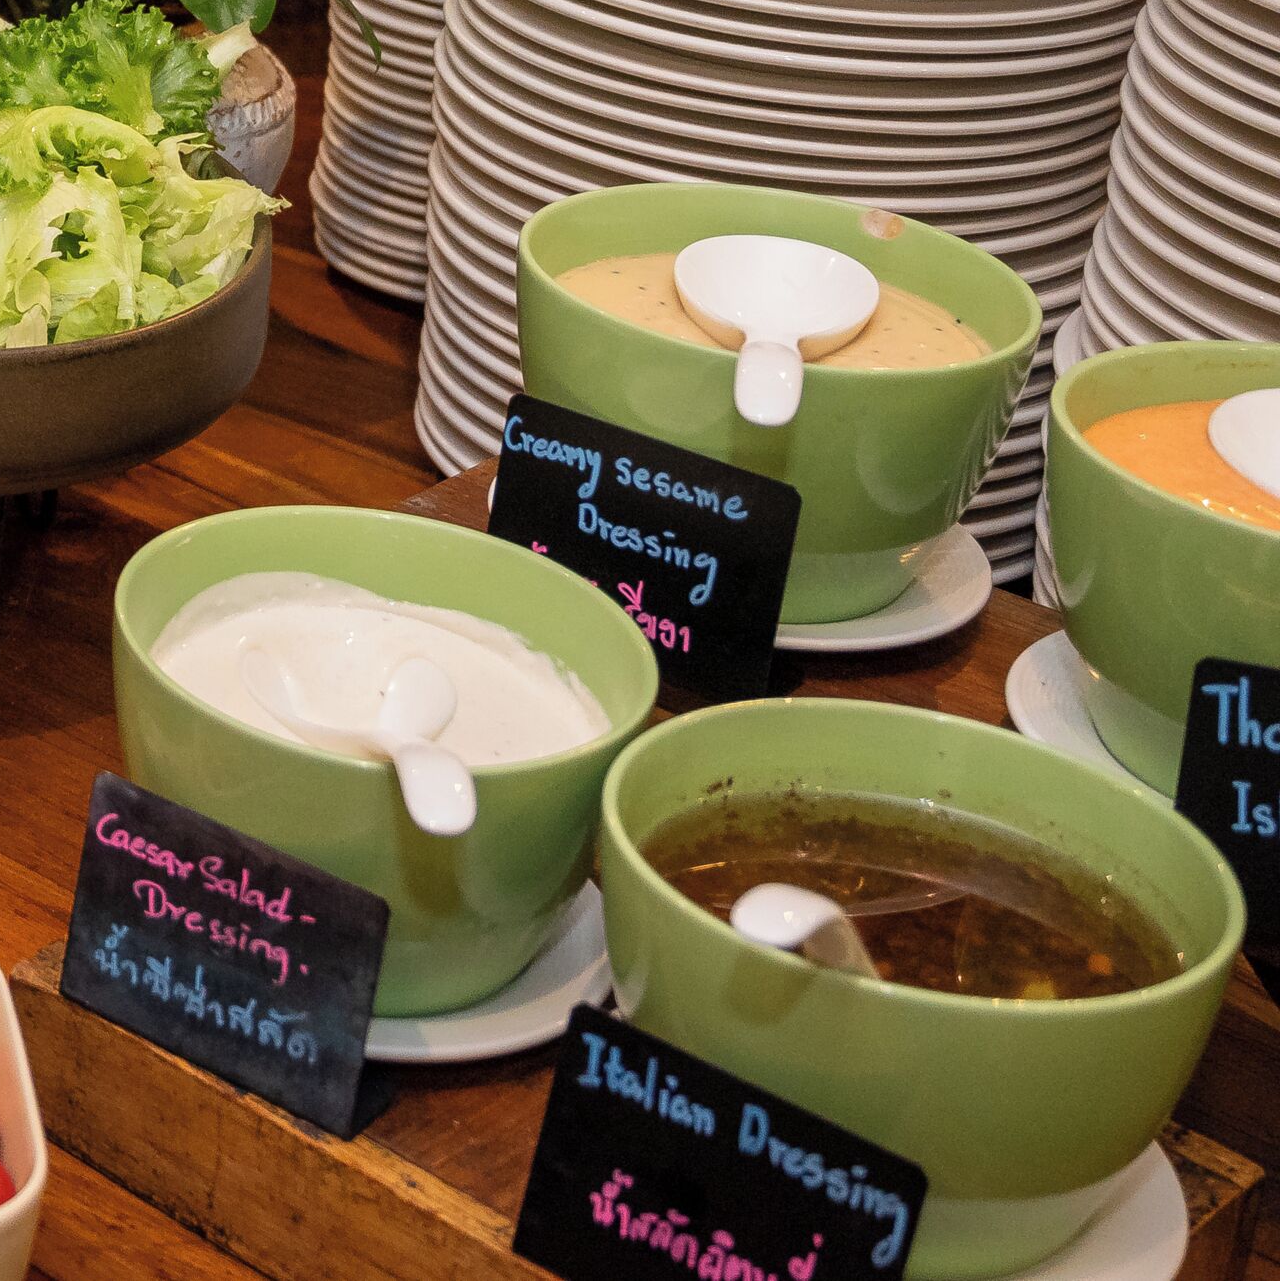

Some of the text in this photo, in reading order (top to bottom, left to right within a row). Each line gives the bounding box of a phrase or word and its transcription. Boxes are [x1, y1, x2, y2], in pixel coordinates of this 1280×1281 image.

[503, 415, 602, 500] Creamy
[577, 502, 719, 606] Dressing
[95, 812, 196, 879] Caesar
[1230, 779, 1280, 837] Is
[577, 1031, 909, 1269] Italian Dressing
